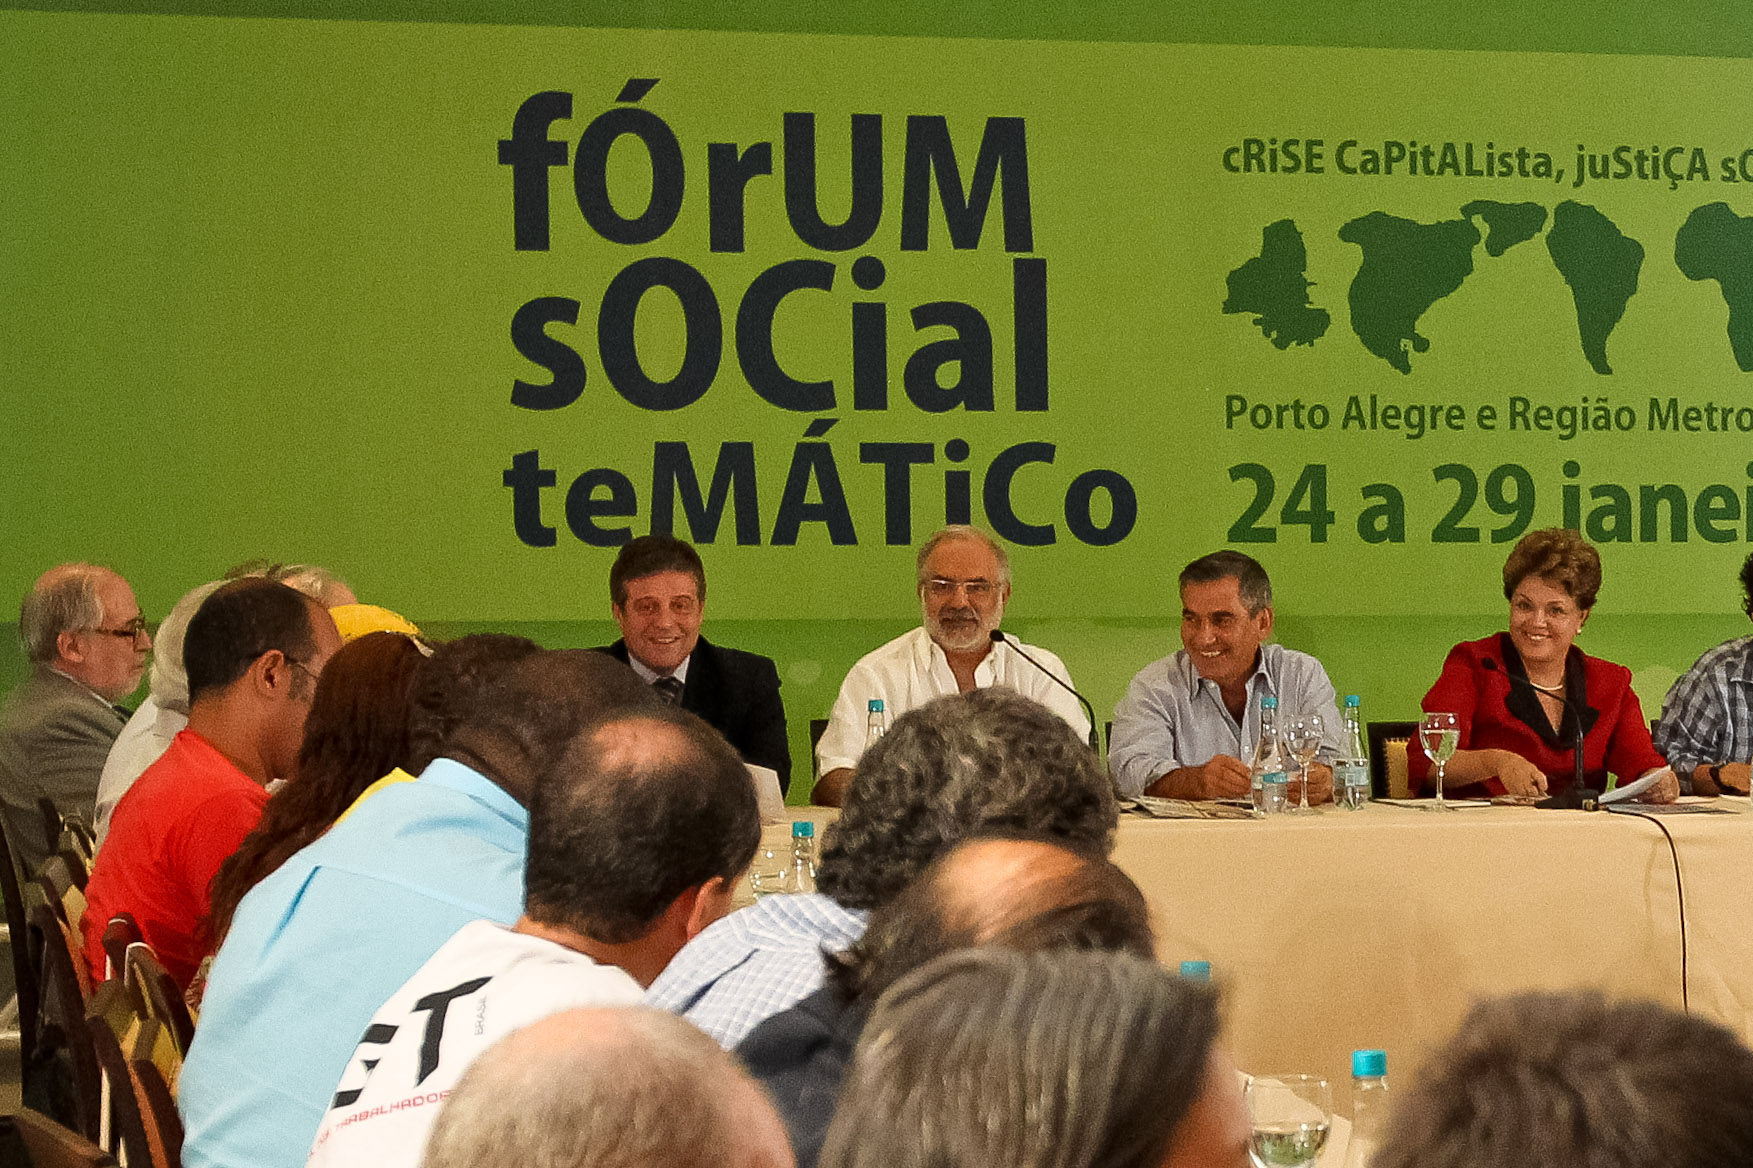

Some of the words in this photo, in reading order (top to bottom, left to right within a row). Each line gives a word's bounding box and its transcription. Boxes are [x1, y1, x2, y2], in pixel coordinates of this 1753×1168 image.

[496, 77, 1035, 254] fÓrUM
[1222, 137, 1325, 175] cRiSE
[1334, 139, 1565, 184] CaPitALista,
[1572, 143, 1712, 191] juStiÇA
[509, 255, 1050, 414] sOCial
[1225, 394, 1330, 431] Porto
[1341, 393, 1466, 441] Alegre
[1476, 404, 1498, 431] e
[1509, 395, 1637, 441] Região
[502, 417, 1139, 548] teMÁTiCo
[1226, 462, 1336, 544] 24
[1356, 482, 1406, 545] a
[1431, 462, 1536, 545] 29
